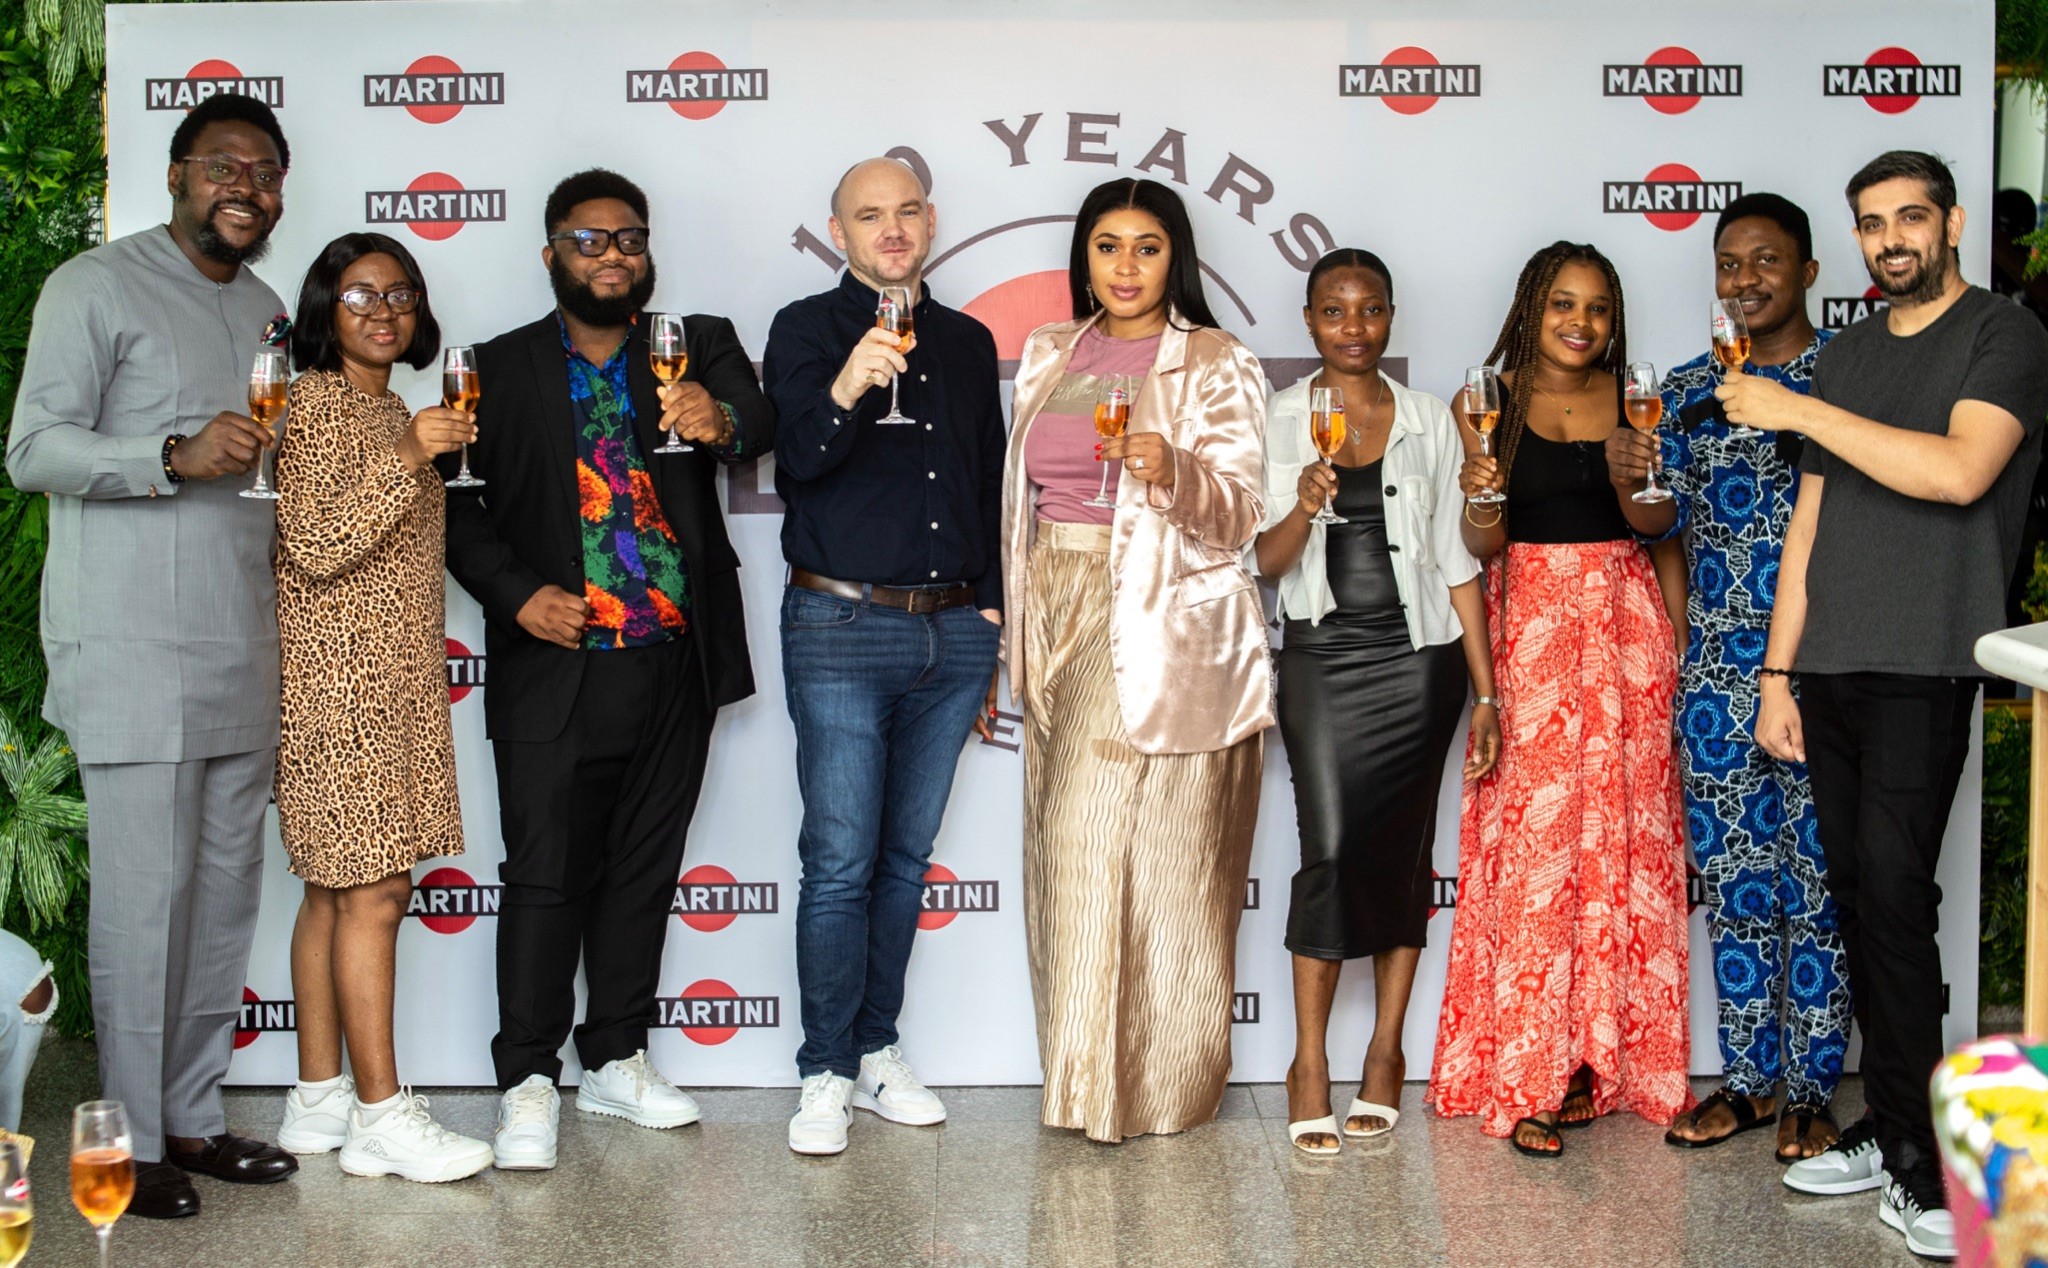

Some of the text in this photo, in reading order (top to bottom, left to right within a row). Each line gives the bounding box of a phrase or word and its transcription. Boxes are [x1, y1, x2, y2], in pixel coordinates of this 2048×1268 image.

[369, 77, 500, 102] MARTINI
[632, 73, 763, 99] MARTINI
[1345, 68, 1475, 93] MARTINI
[1608, 68, 1738, 93] MARTINI
[1828, 68, 1956, 93] MARTINI
[982, 111, 1339, 274] YEARS
[1608, 184, 1738, 211] MARTINI
[370, 193, 500, 219] MARTINI
[406, 888, 500, 913] ARTIN
[670, 886, 773, 911] ARTINI
[239, 1004, 295, 1029] TINI
